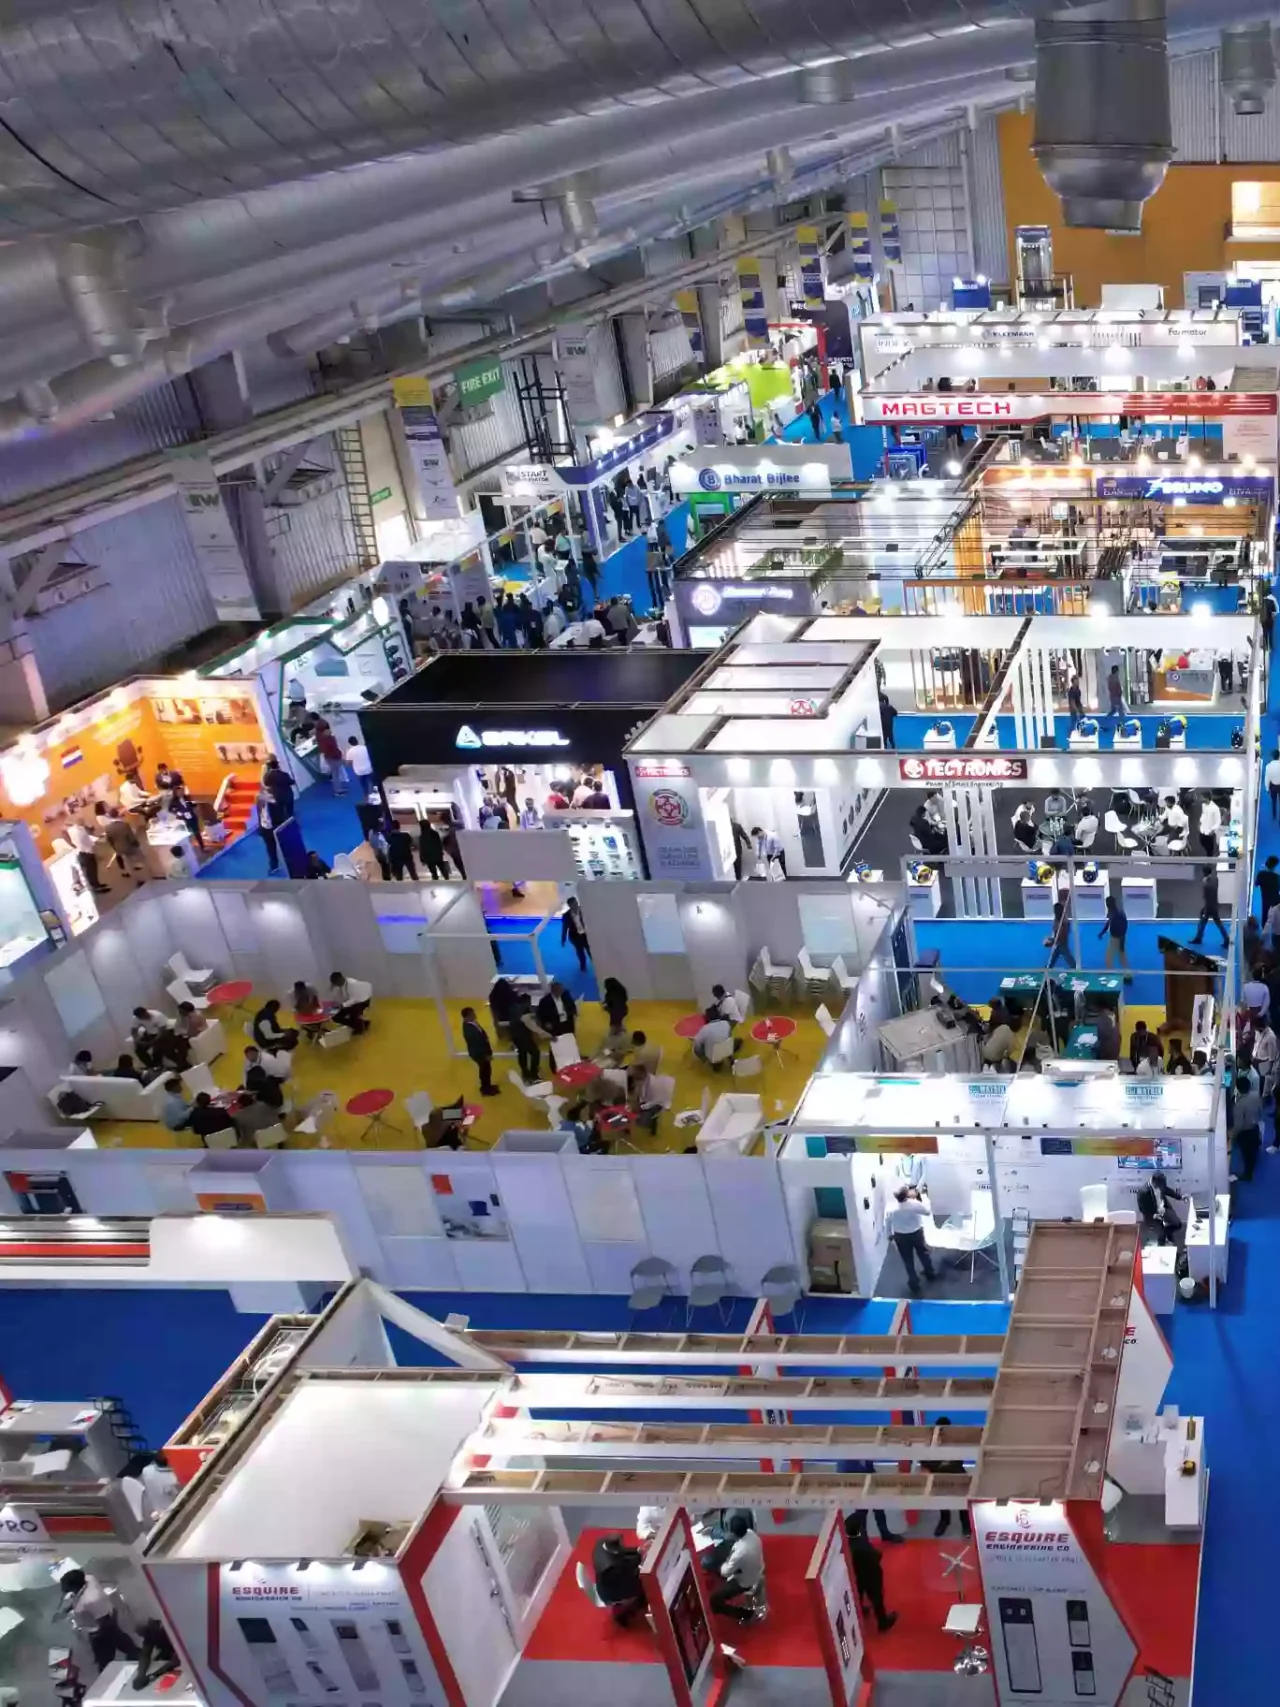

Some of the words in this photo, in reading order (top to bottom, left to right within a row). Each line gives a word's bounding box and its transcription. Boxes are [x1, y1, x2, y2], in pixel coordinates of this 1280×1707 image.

[461, 376, 482, 394] FIRE
[481, 366, 500, 386] EXIT
[882, 402, 1011, 416] MAGTECH
[724, 474, 762, 485] Bharat
[766, 475, 800, 485] Bijlee
[925, 760, 1022, 776] TECTRONICS
[985, 1531, 1069, 1544] ESQUIRE
[232, 1586, 300, 1596] ESQUIRE
